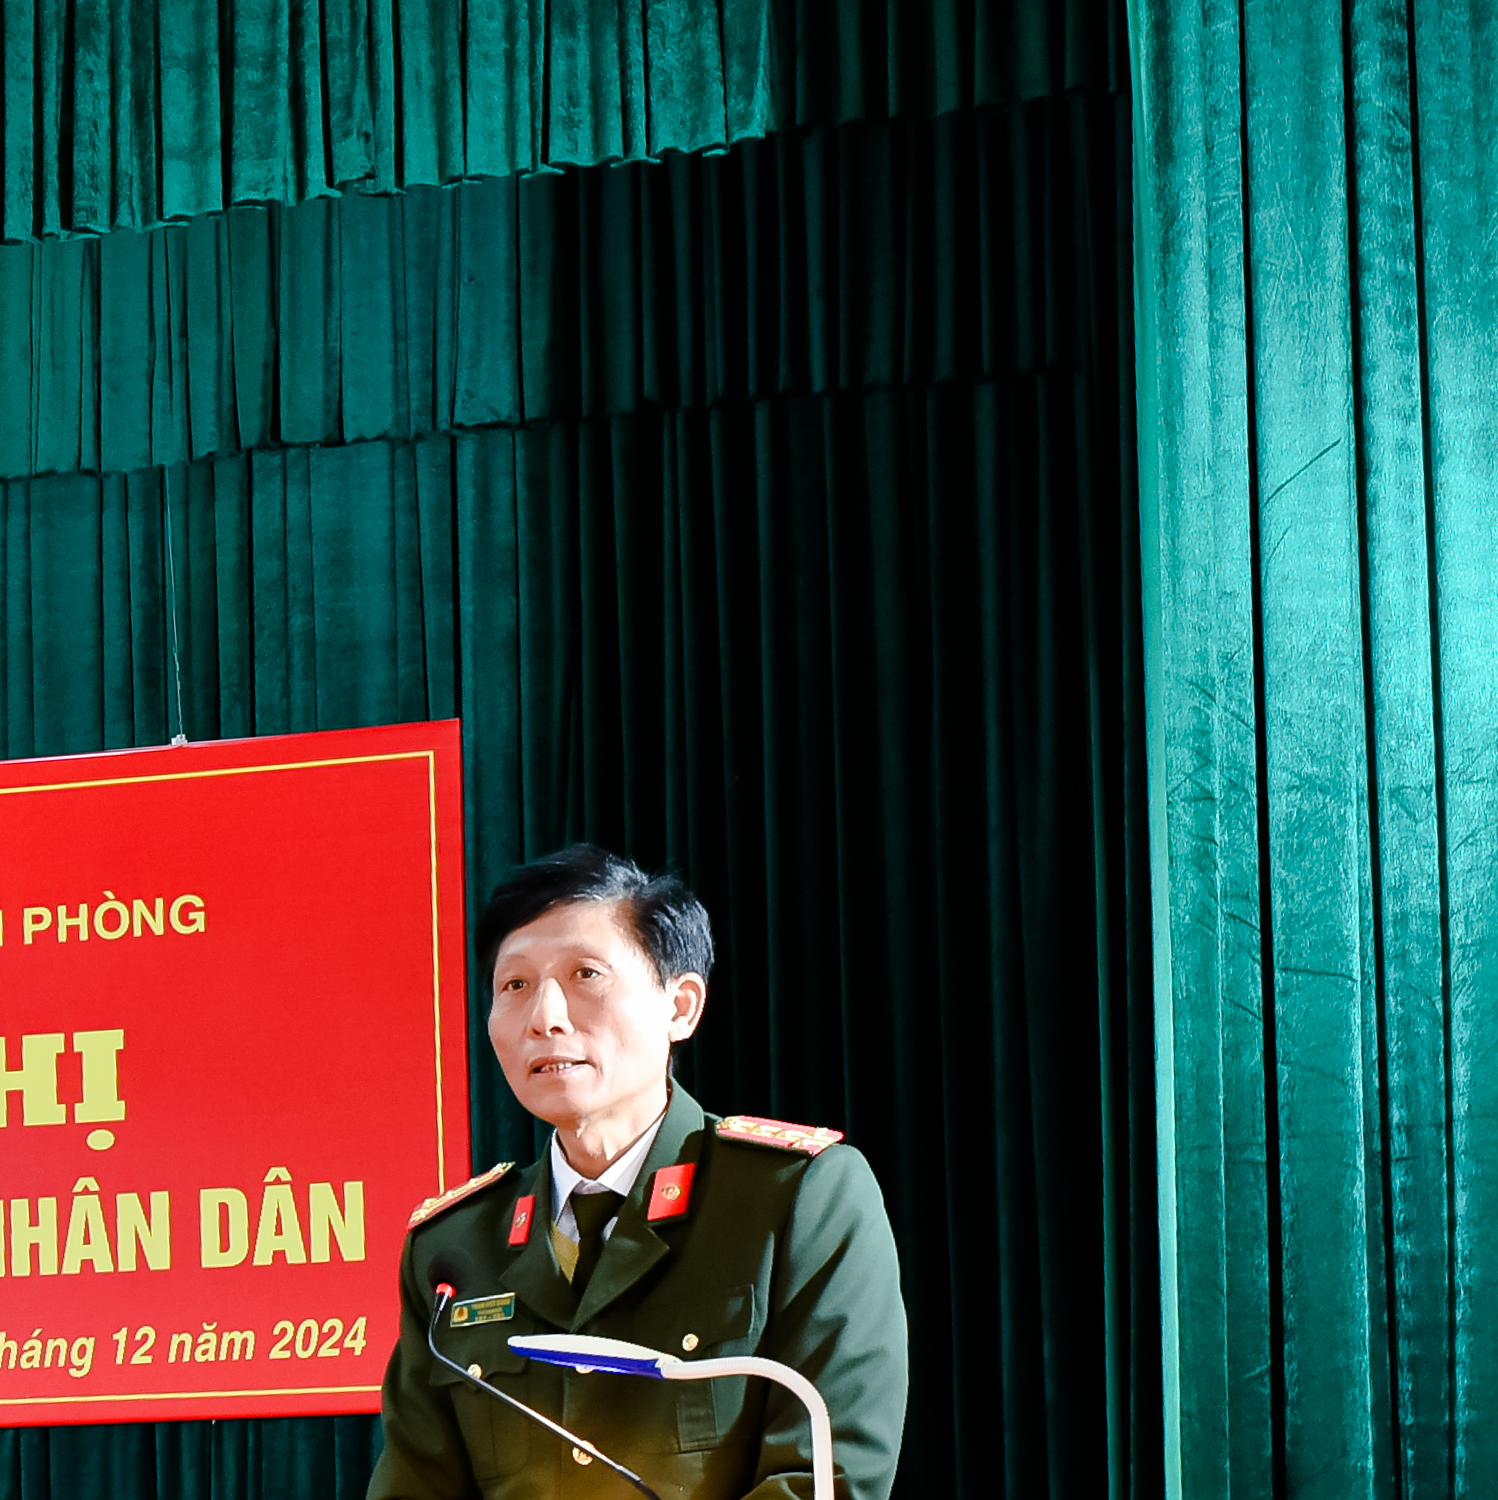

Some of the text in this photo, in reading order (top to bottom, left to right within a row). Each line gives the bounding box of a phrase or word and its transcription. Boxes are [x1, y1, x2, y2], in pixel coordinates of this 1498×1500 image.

[24, 889, 205, 944] PHÒNG
[200, 1167, 365, 1268] DÂN
[113, 1326, 156, 1364] 12
[168, 1321, 255, 1363] năm
[269, 1317, 367, 1359] 2024
